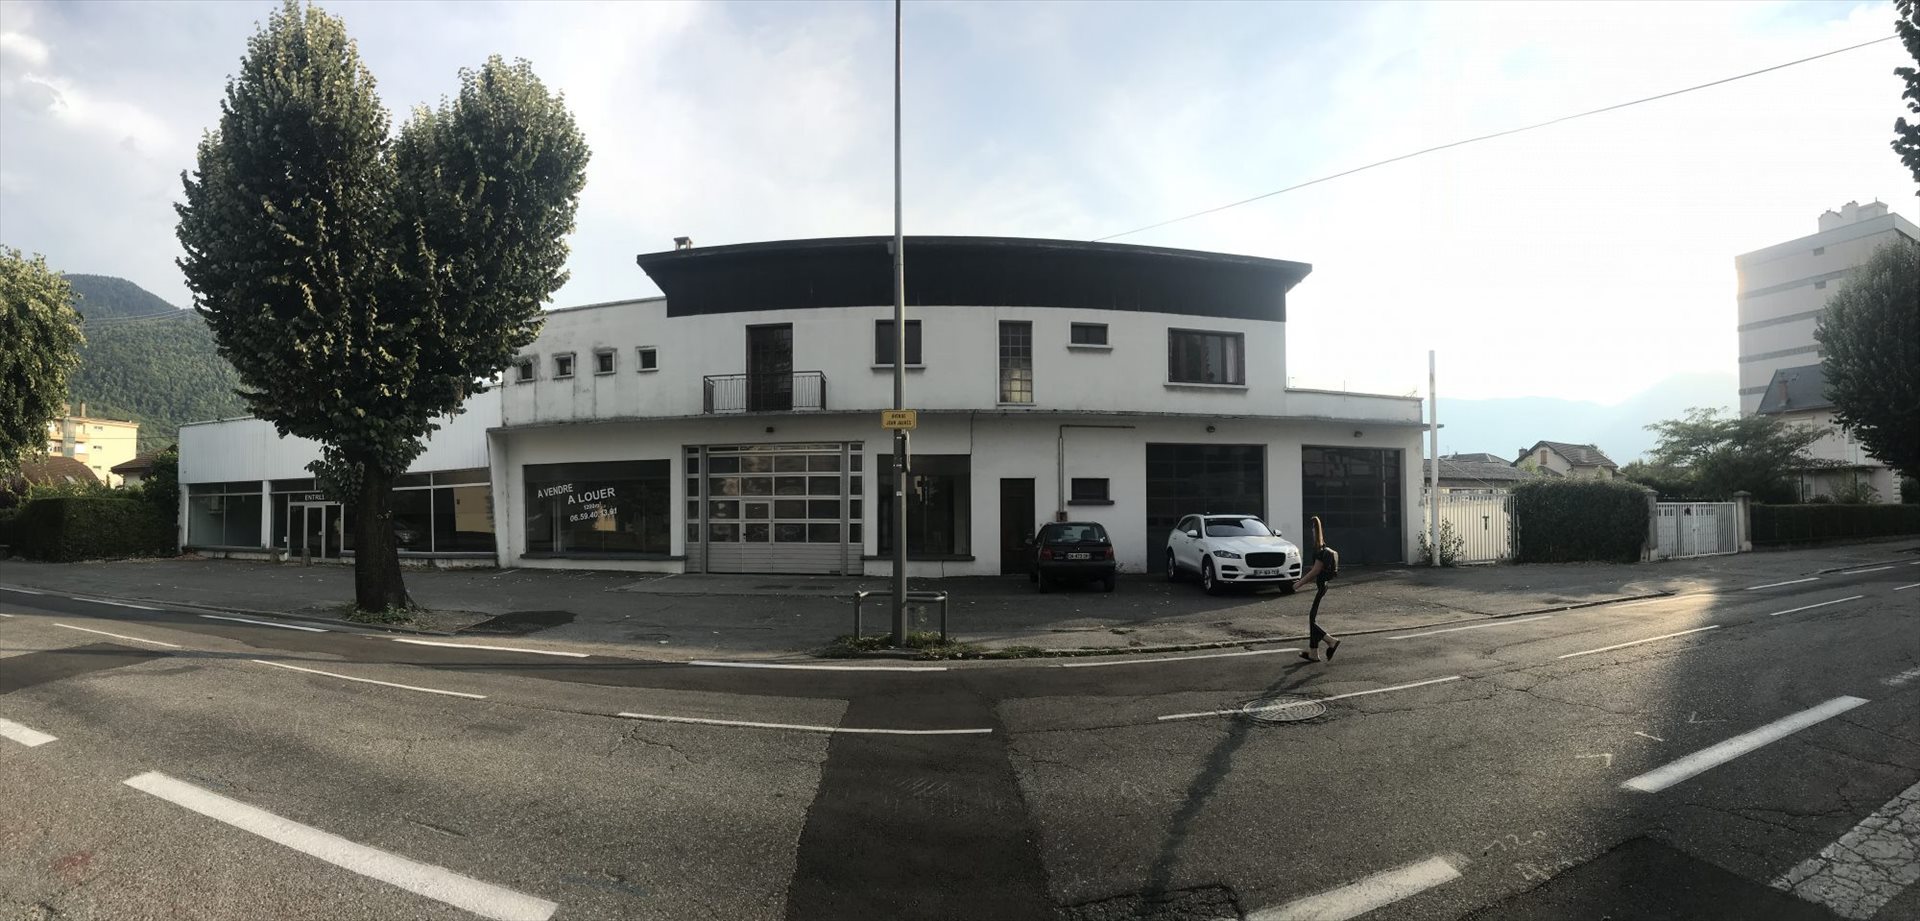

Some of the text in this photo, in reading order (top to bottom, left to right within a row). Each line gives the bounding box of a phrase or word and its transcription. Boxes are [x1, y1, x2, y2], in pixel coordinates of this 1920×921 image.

[537, 483, 573, 498] A VENDRE
[567, 487, 616, 505] A LOUER
